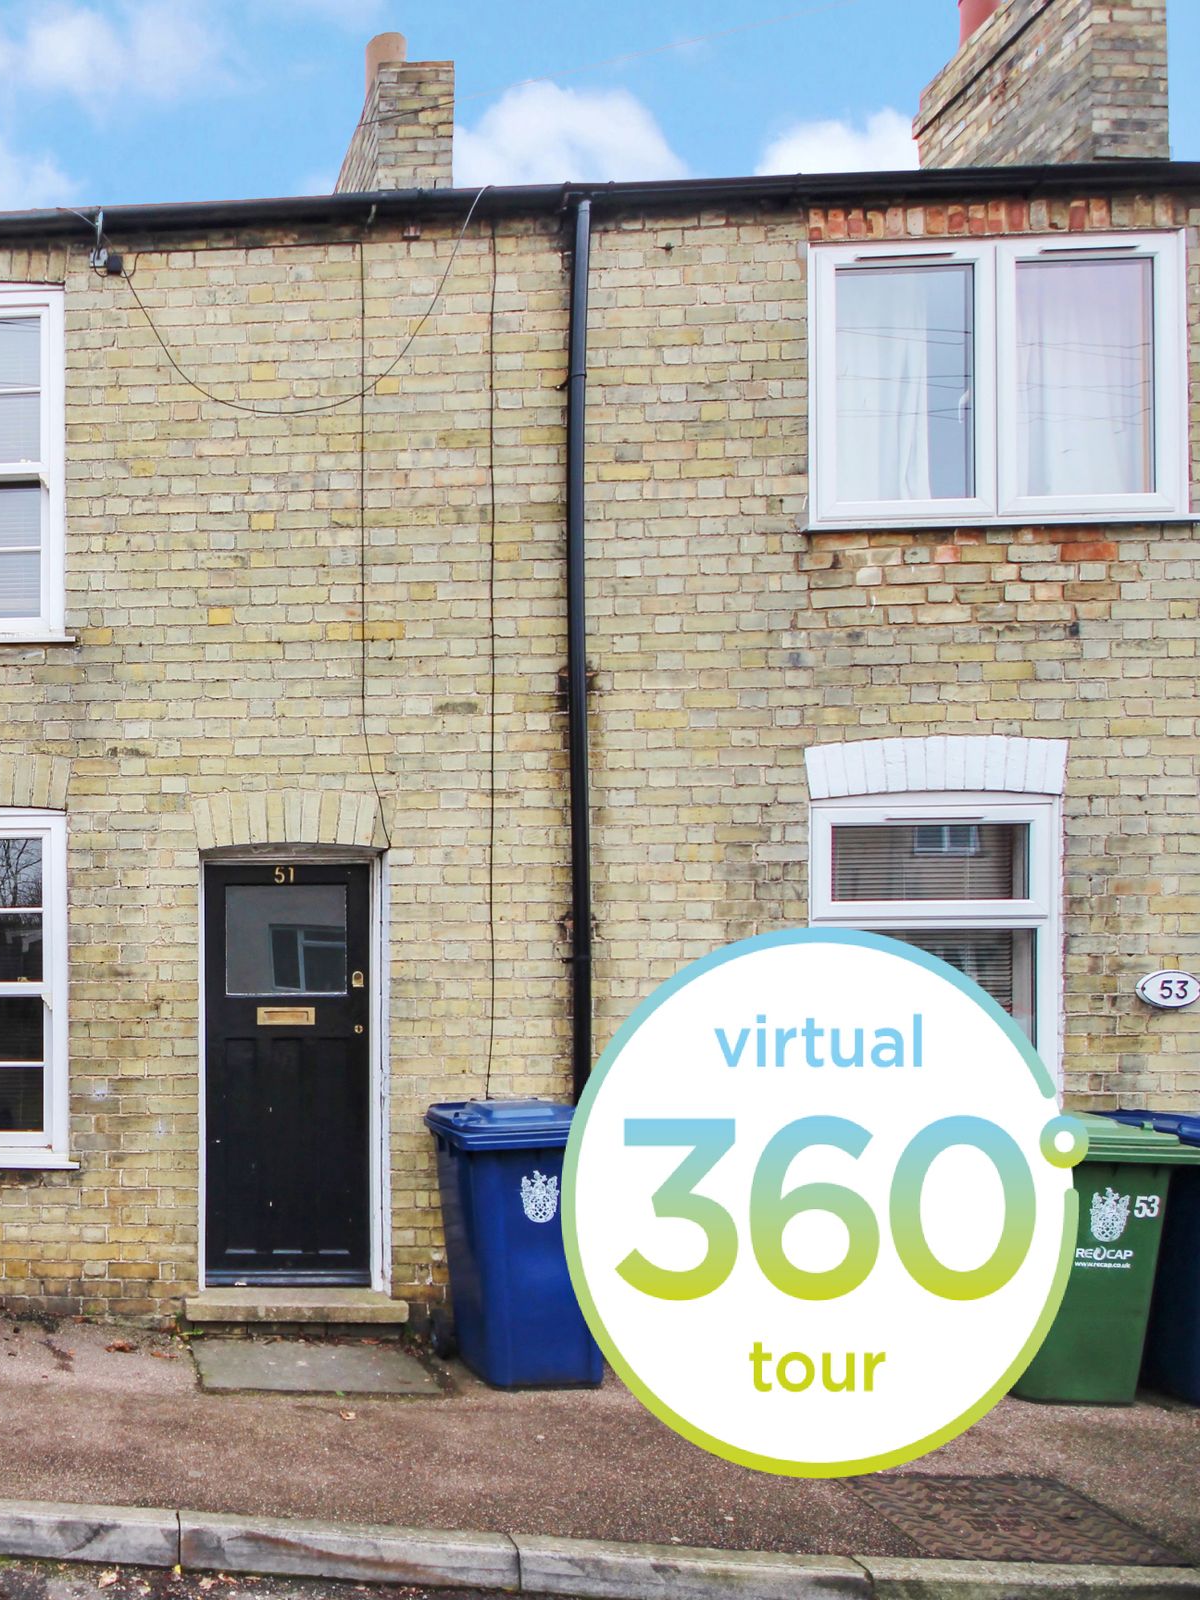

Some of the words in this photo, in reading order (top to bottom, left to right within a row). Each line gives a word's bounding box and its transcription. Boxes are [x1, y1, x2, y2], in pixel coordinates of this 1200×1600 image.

[274, 867, 295, 883] 51
[1160, 980, 1189, 999] 53
[1134, 1195, 1160, 1218] 53
[1075, 1261, 1131, 1269] www.recap.co.uk
